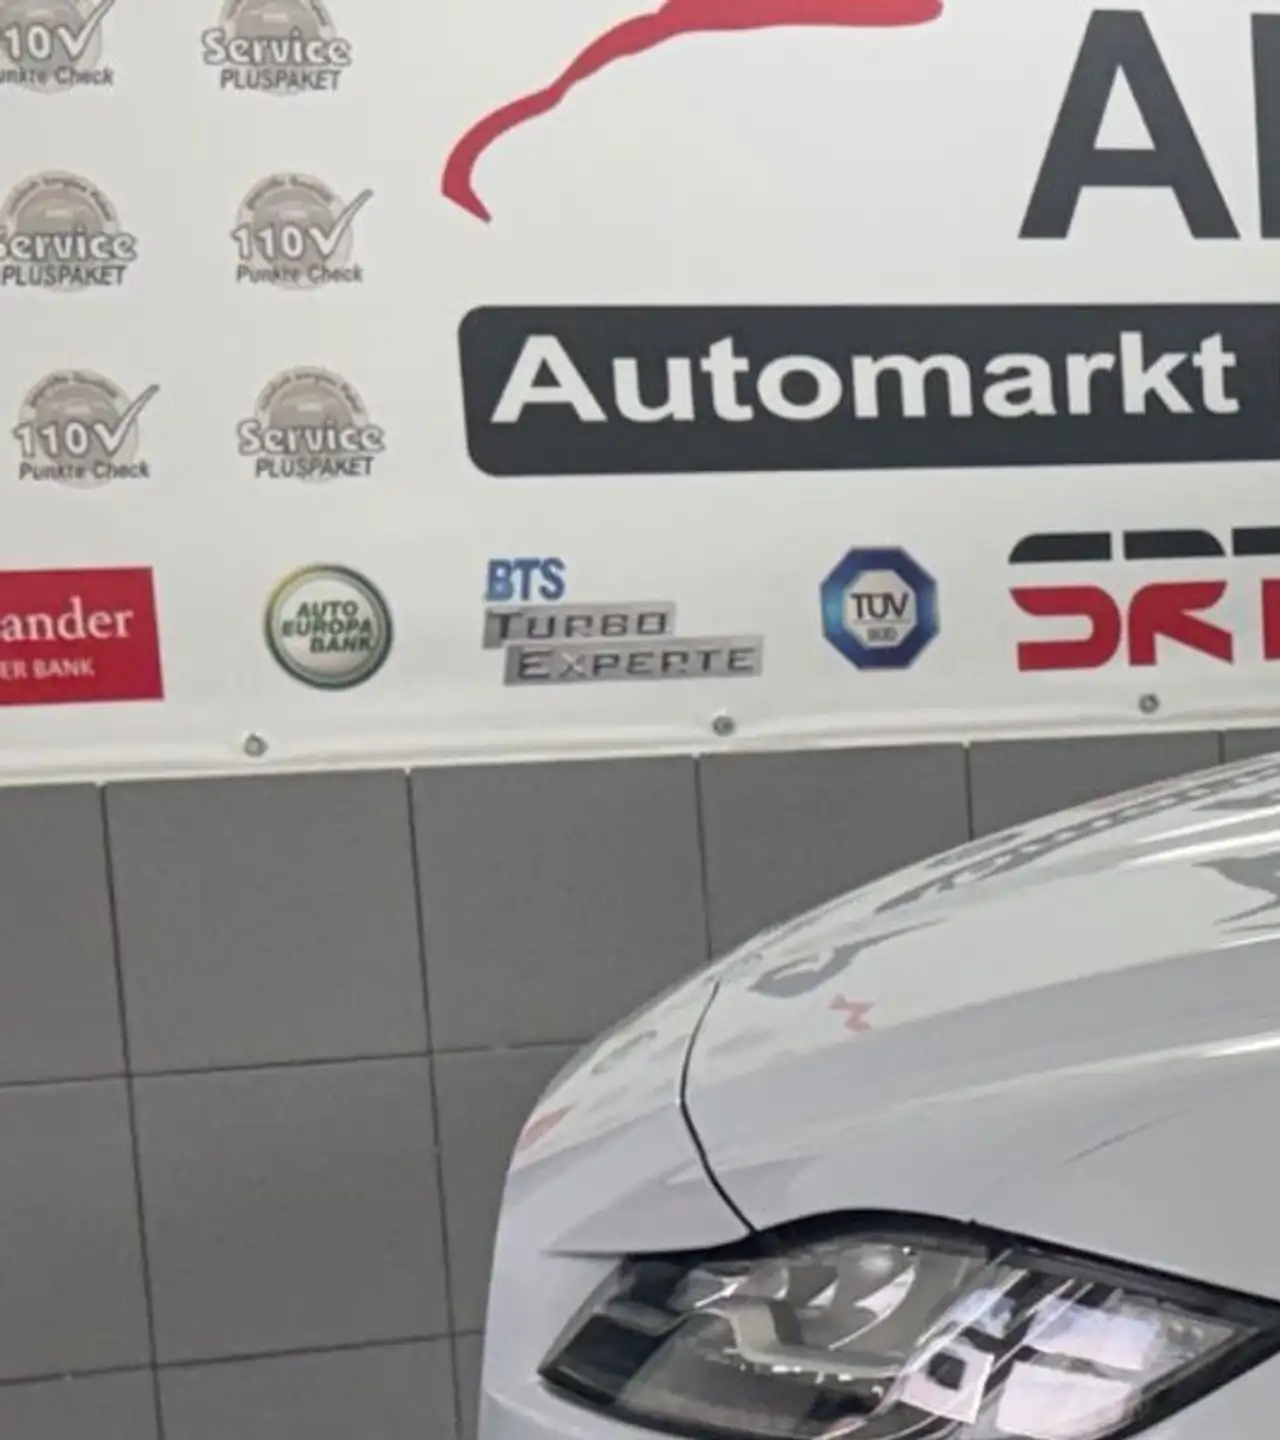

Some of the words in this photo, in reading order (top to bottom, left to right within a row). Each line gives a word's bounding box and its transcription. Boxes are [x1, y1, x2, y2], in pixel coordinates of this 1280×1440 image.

[201, 24, 353, 66] Service
[220, 68, 342, 90] PLUSPAKET
[2, 264, 127, 286] PLUSPAKET
[490, 330, 1240, 424] Automarkt
[237, 416, 386, 456] Service
[254, 455, 376, 478] PLUSPAKET
[485, 557, 567, 602] BTS
[0, 595, 135, 643] ander
[296, 600, 358, 618] AUTO
[282, 616, 373, 638] EUROPA
[488, 611, 669, 640] TURBO
[309, 636, 376, 655] BANK
[33, 656, 96, 681] BANK
[517, 647, 757, 681] EXPERTE
